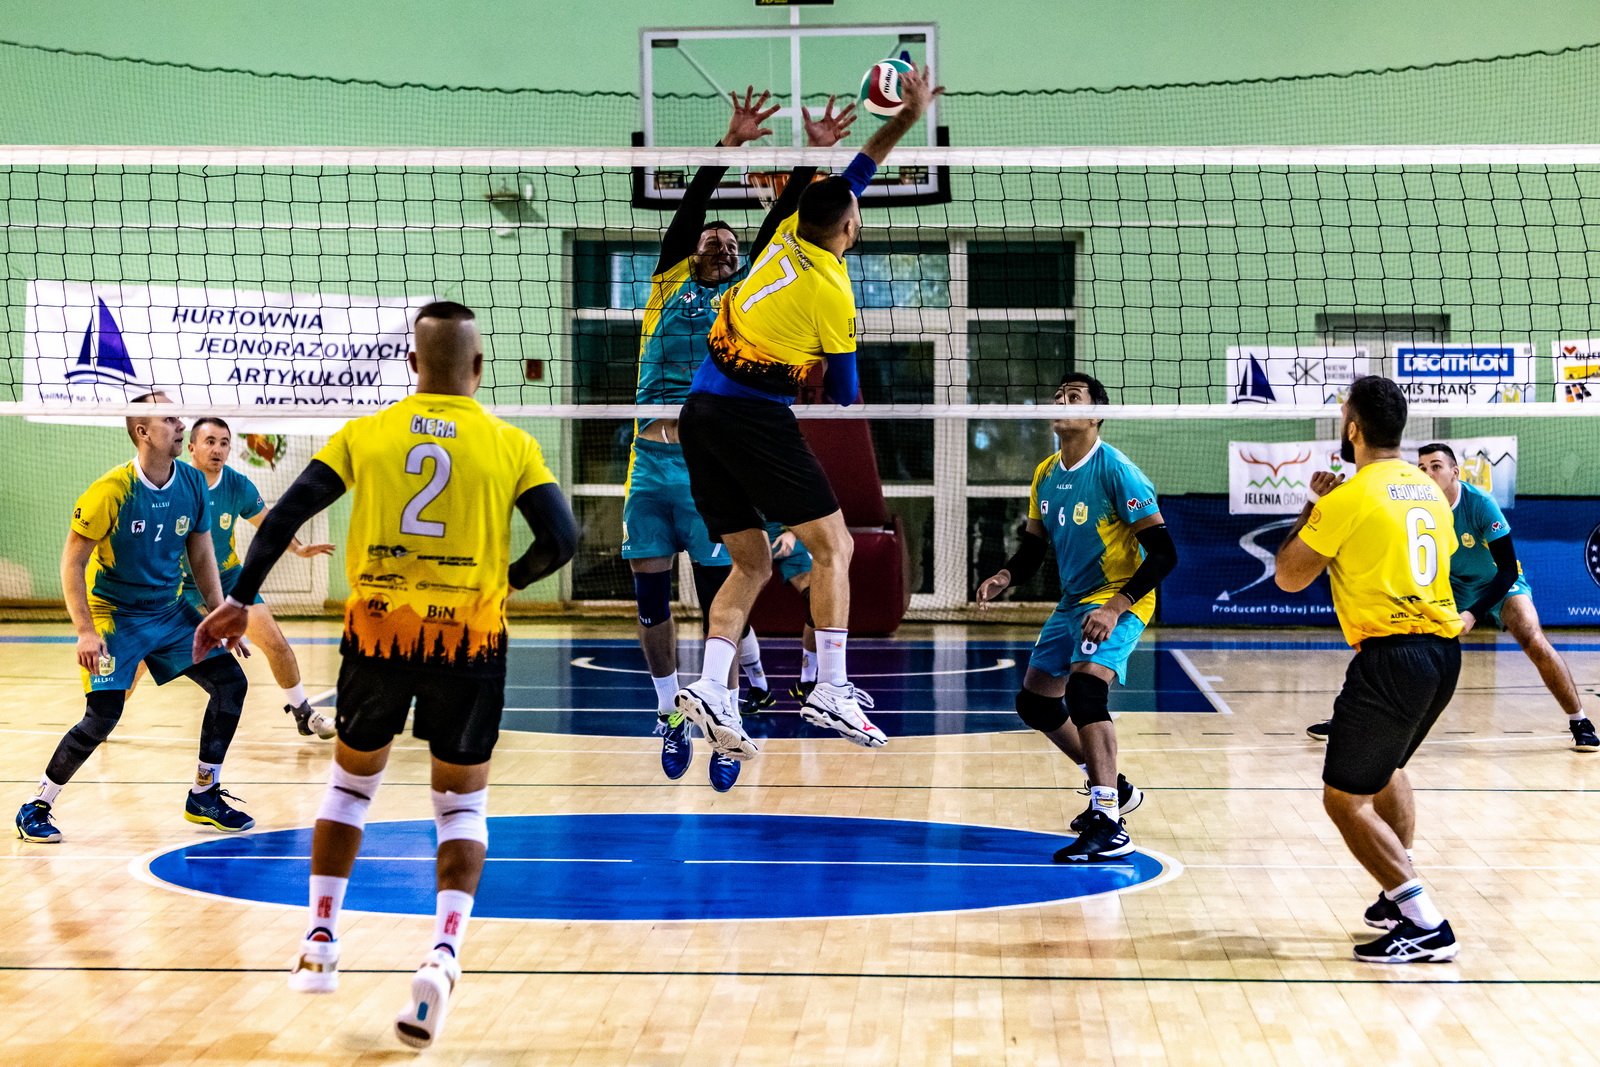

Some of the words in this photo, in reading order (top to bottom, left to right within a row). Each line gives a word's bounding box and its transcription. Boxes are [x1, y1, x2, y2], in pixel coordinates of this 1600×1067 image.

[736, 242, 799, 314] 17
[172, 308, 323, 330] HURTOWNIA
[195, 337, 410, 359] JEDNORAZOWYCH
[1403, 353, 1509, 372] DECATHLON
[227, 366, 379, 386] ARTYKUŁÓW
[1429, 384, 1477, 396] TRANS
[410, 414, 457, 438] GIERA
[400, 441, 452, 538] 2
[1244, 493, 1282, 504] JELENIA
[1058, 506, 1066, 527] 6
[154, 523, 164, 542] 2
[1406, 507, 1438, 586] 6
[1212, 604, 1267, 613] Producent
[1270, 604, 1307, 615] Dobrej
